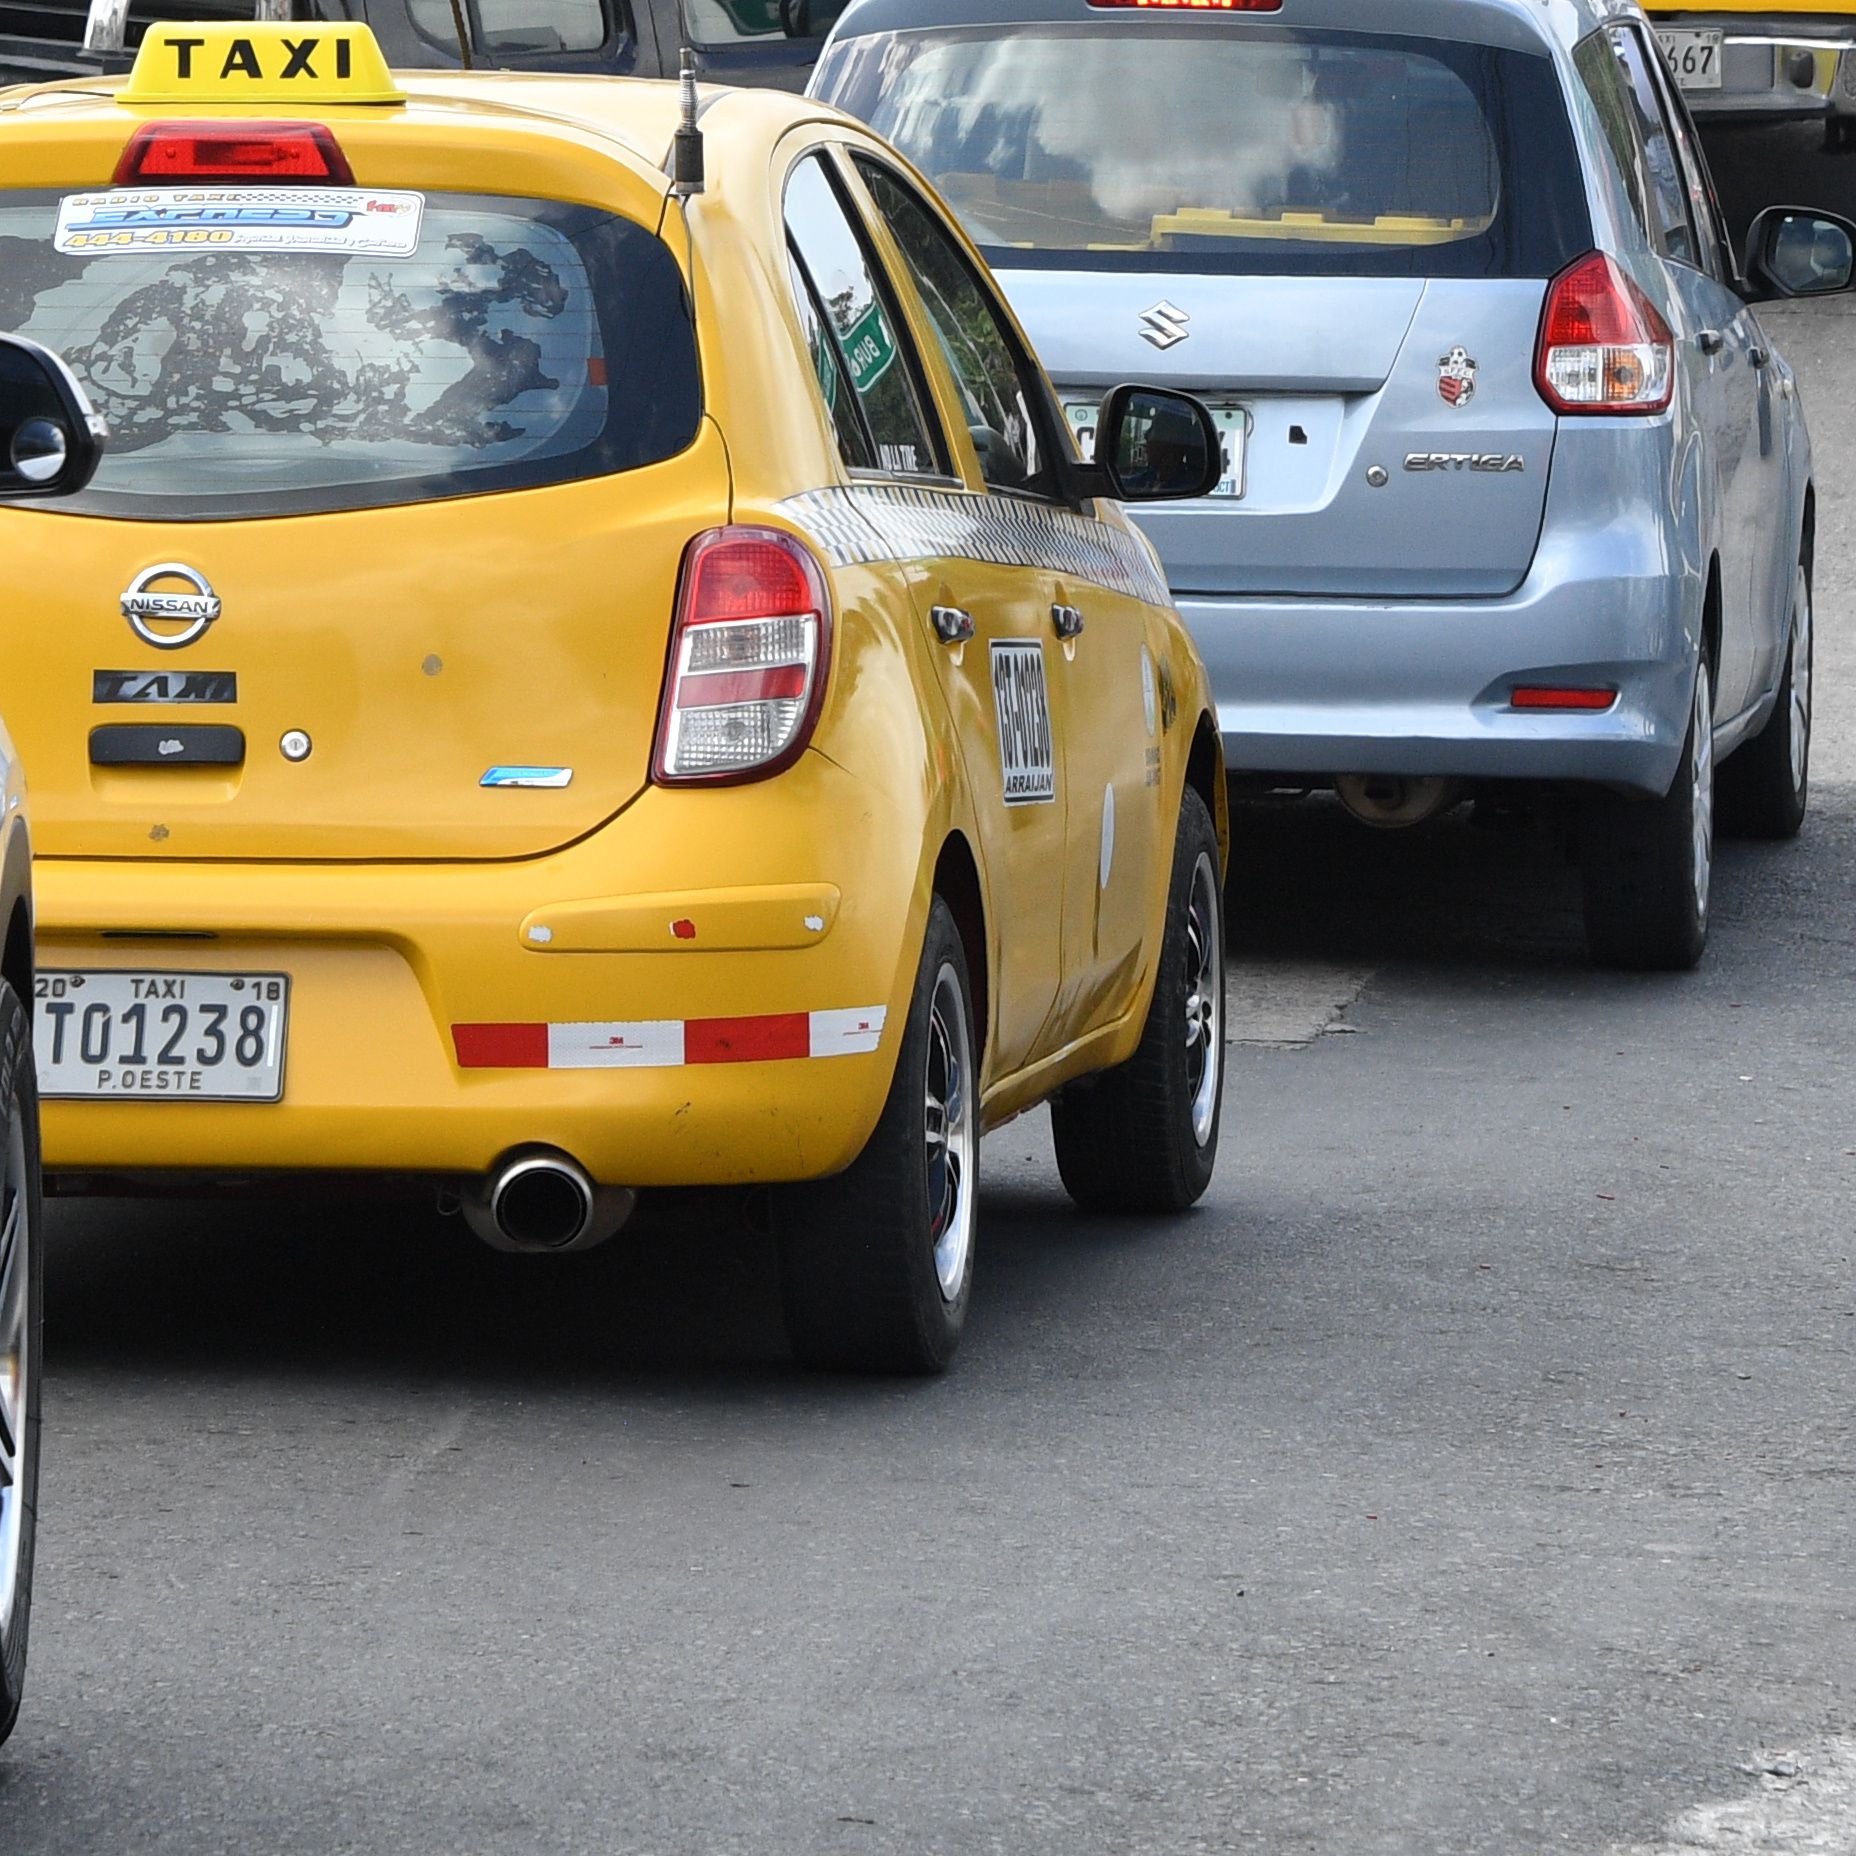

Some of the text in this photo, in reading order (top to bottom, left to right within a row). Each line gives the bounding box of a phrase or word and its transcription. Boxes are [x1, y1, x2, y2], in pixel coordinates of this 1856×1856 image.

[164, 38, 351, 80] TAXI
[73, 194, 160, 206] RADIO
[63, 230, 234, 248] 444-4180
[1403, 451, 1525, 472] ERTIGA
[130, 598, 208, 613] NISSAN
[97, 675, 233, 699] TAXI
[1005, 773, 1052, 794] ARRAIJAN
[35, 978, 281, 1001] 20 TAXI 18
[45, 1002, 265, 1067] T01238
[609, 1037, 624, 1045] 3M
[97, 1070, 202, 1090] P.OESTE
